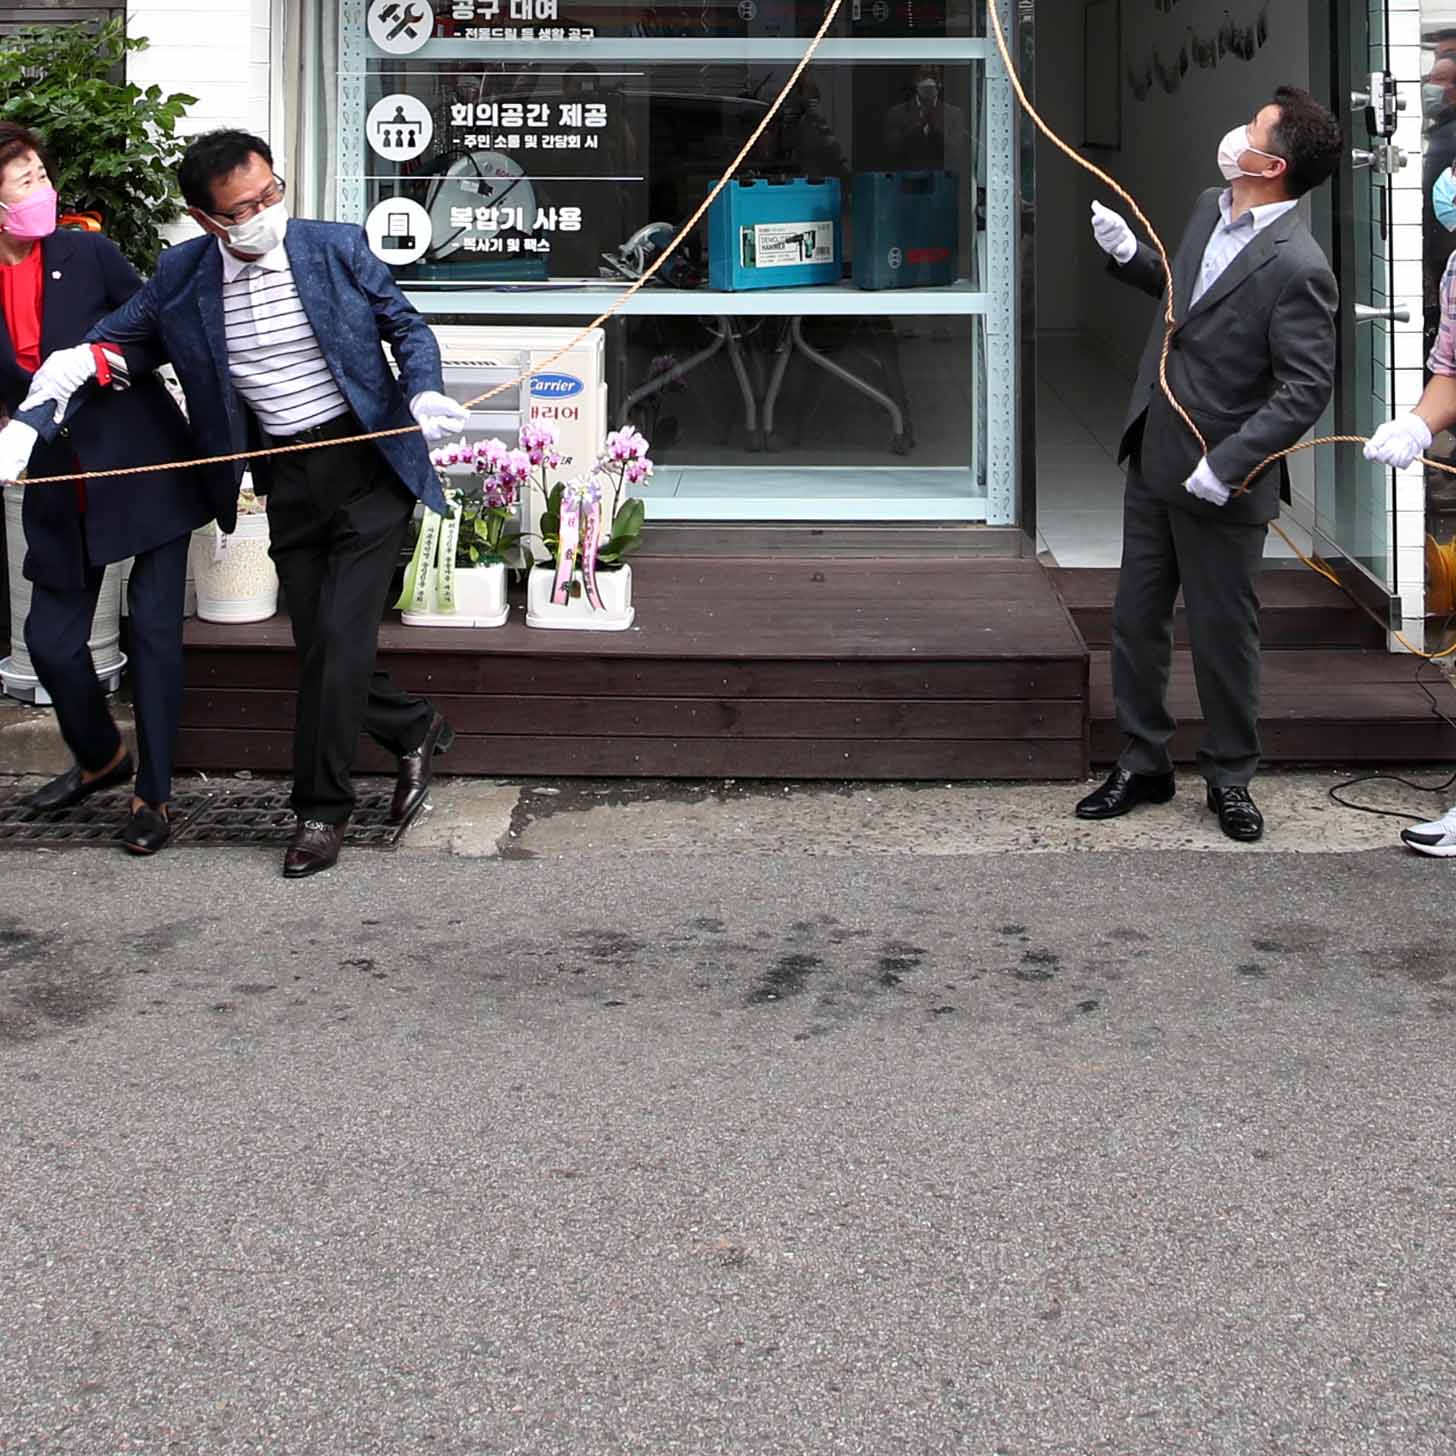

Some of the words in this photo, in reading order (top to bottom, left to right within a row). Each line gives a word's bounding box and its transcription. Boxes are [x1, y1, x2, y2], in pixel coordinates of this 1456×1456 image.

[450, 103, 550, 127] 회의공간
[558, 103, 607, 127] 제공
[463, 134, 490, 149] 주민
[524, 134, 538, 149] 및
[541, 134, 581, 149] 간담회
[584, 134, 598, 149] 시
[450, 206, 524, 231] 복합기
[532, 206, 582, 231] 사용
[507, 237, 520, 252] 및
